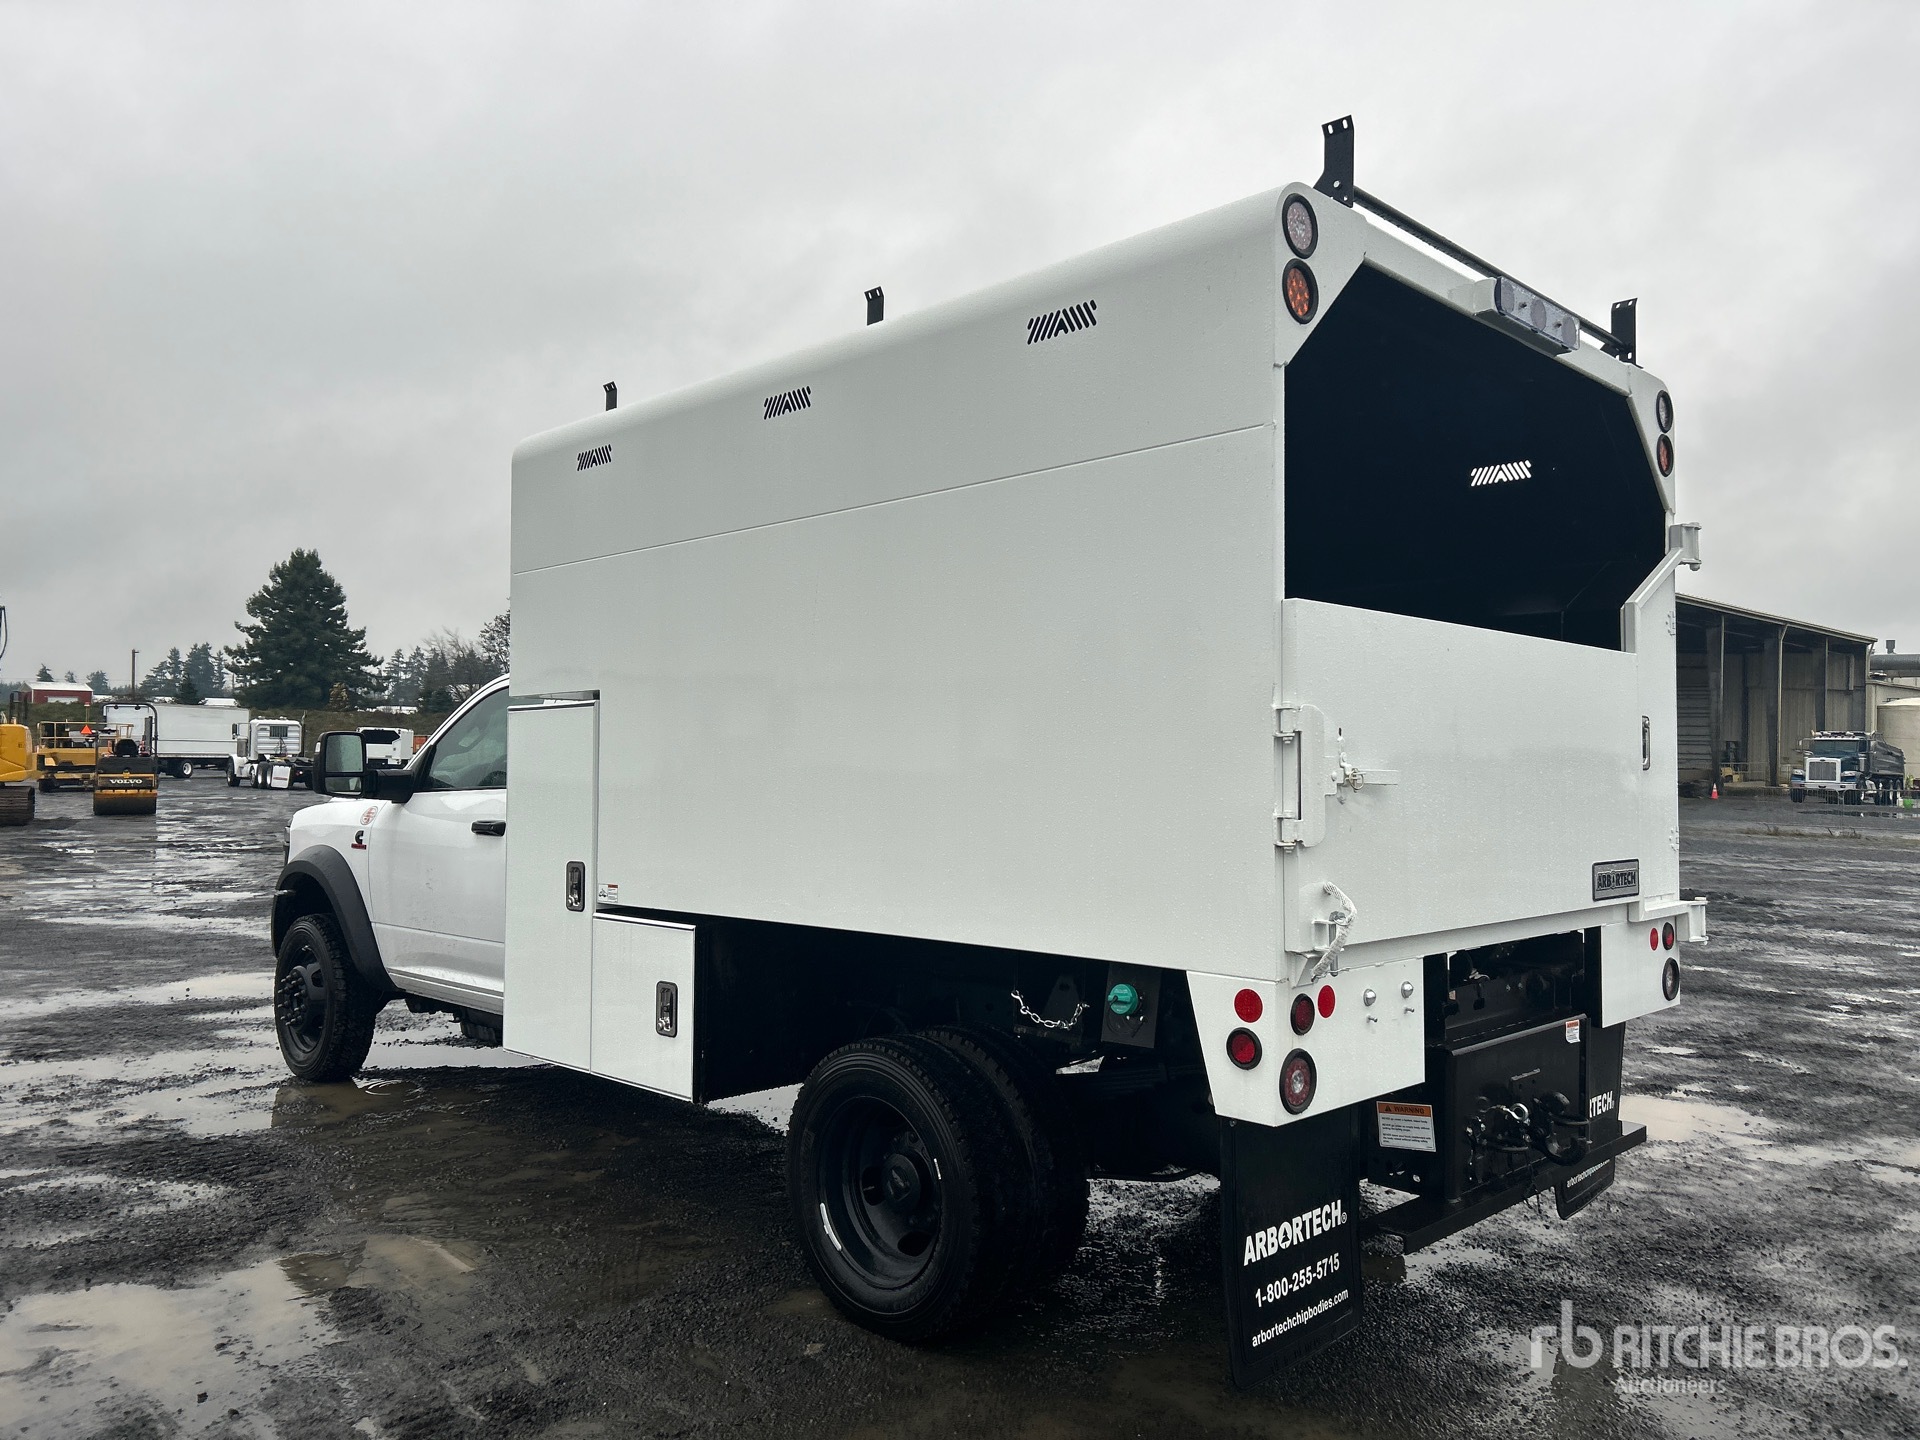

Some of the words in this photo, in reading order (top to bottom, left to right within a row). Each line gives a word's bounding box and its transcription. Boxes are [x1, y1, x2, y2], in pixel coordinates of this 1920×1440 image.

[1394, 1105, 1425, 1115] WARNING
[1255, 1252, 1340, 1308] 1-800-255-5715
[1251, 1289, 1349, 1348] arbortechchipbodies.com
